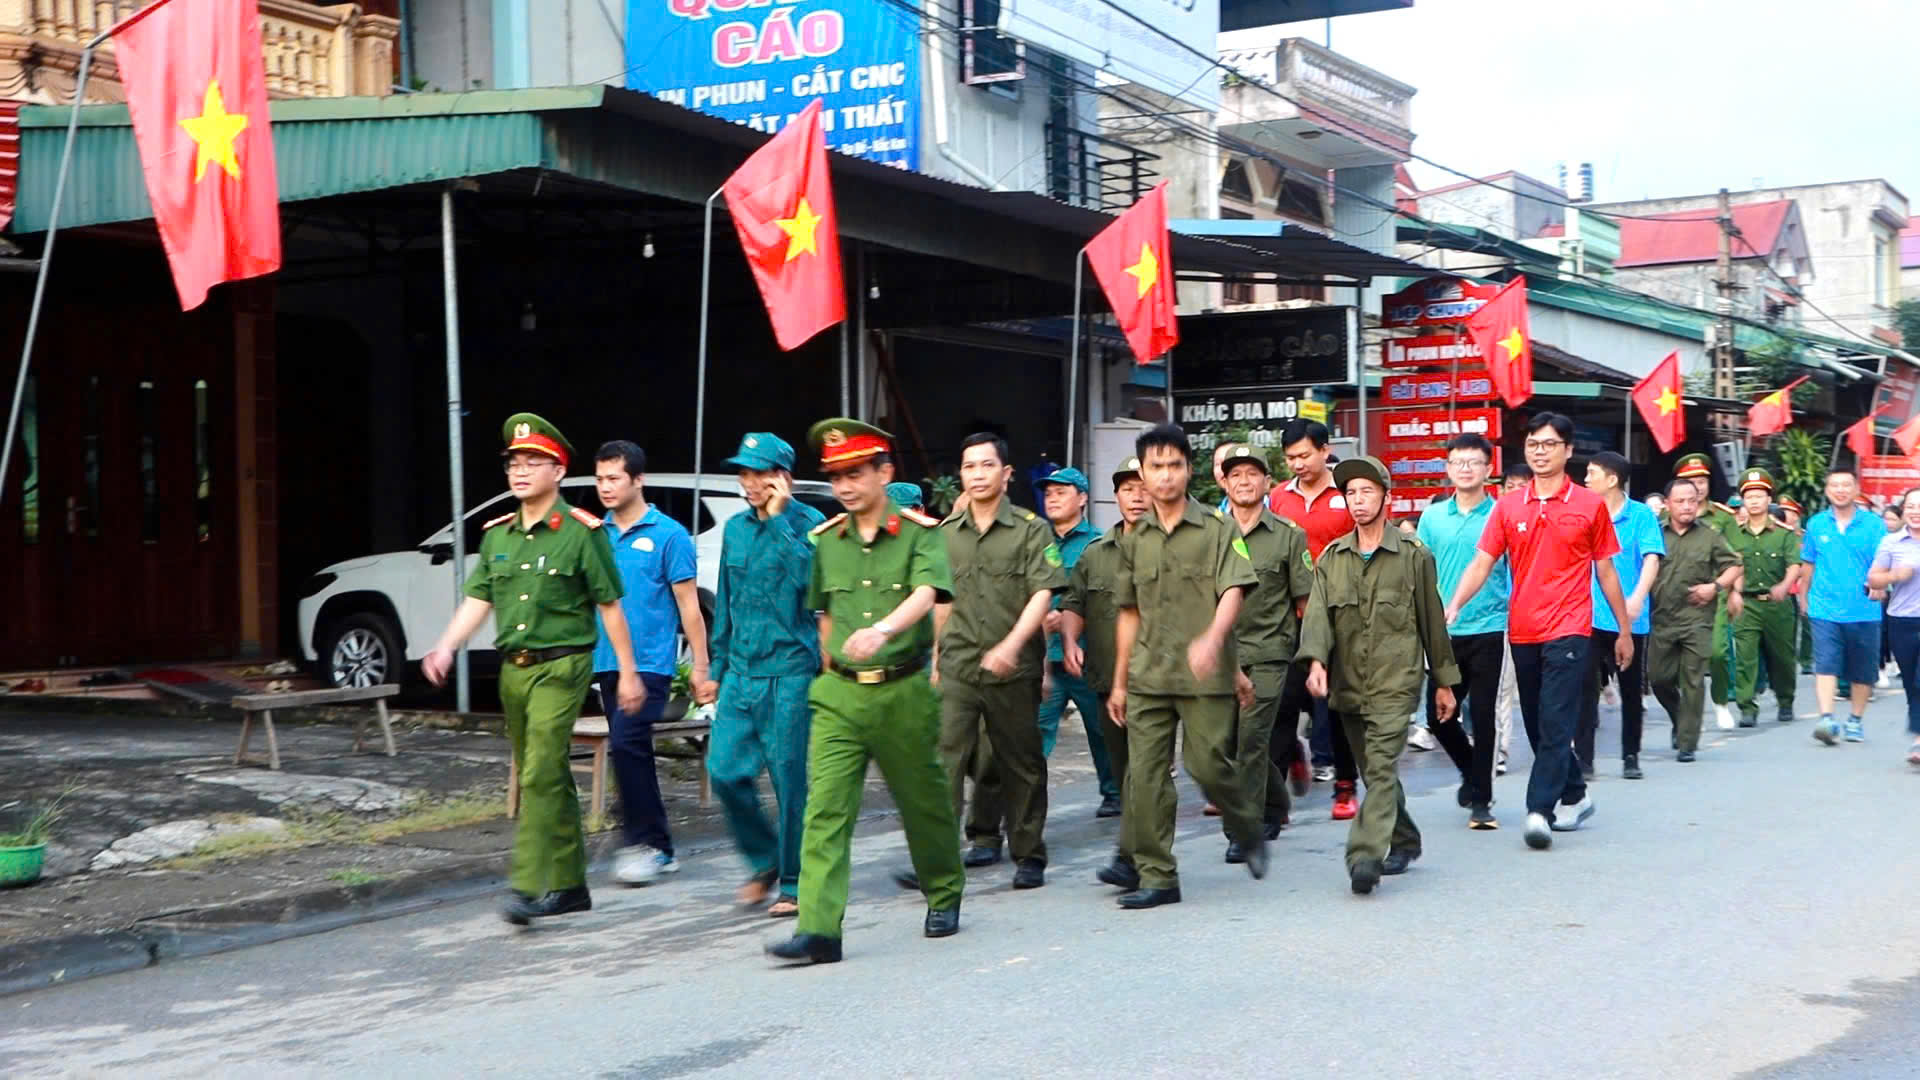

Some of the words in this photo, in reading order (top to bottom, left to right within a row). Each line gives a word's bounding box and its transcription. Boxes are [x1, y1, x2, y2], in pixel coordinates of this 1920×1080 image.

[712, 6, 844, 68] CÁO
[693, 80, 766, 109] PHUN
[791, 63, 845, 97] CẮT
[850, 61, 905, 91] CNC
[840, 94, 907, 130] THẤT
[1182, 398, 1229, 422] KHẮC
[1233, 402, 1264, 420] BIA
[1267, 397, 1297, 422] MỘ
